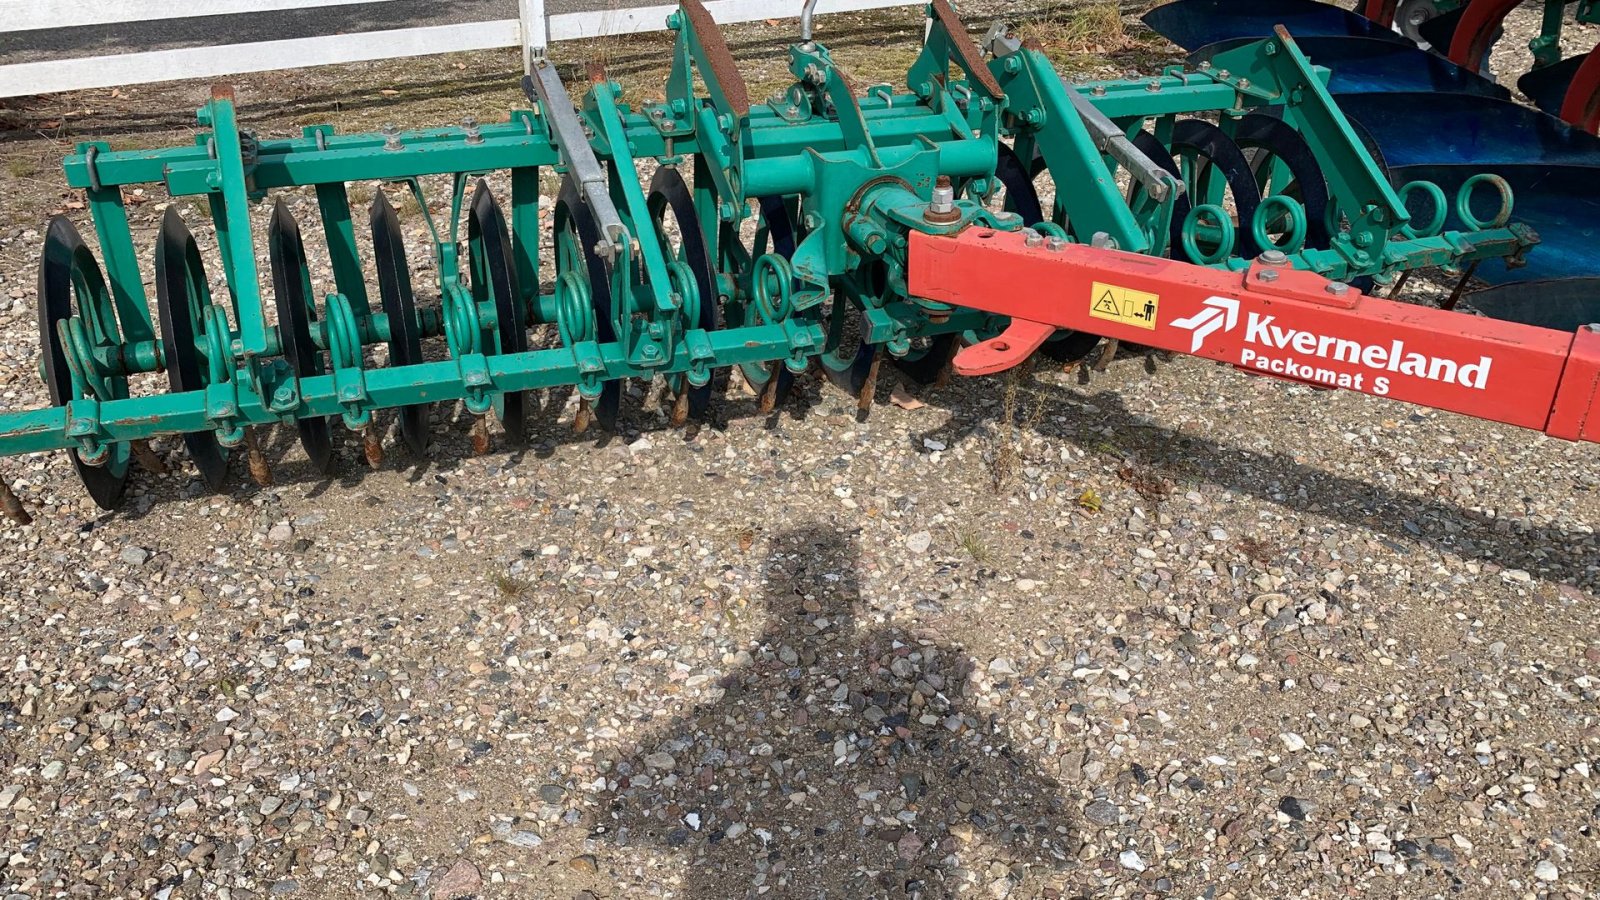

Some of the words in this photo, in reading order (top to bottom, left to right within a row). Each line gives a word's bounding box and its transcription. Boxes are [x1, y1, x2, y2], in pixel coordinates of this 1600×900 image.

[1240, 347, 1364, 391] Packomat
[1373, 376, 1391, 396] S
[1244, 312, 1493, 390] Kverneland
